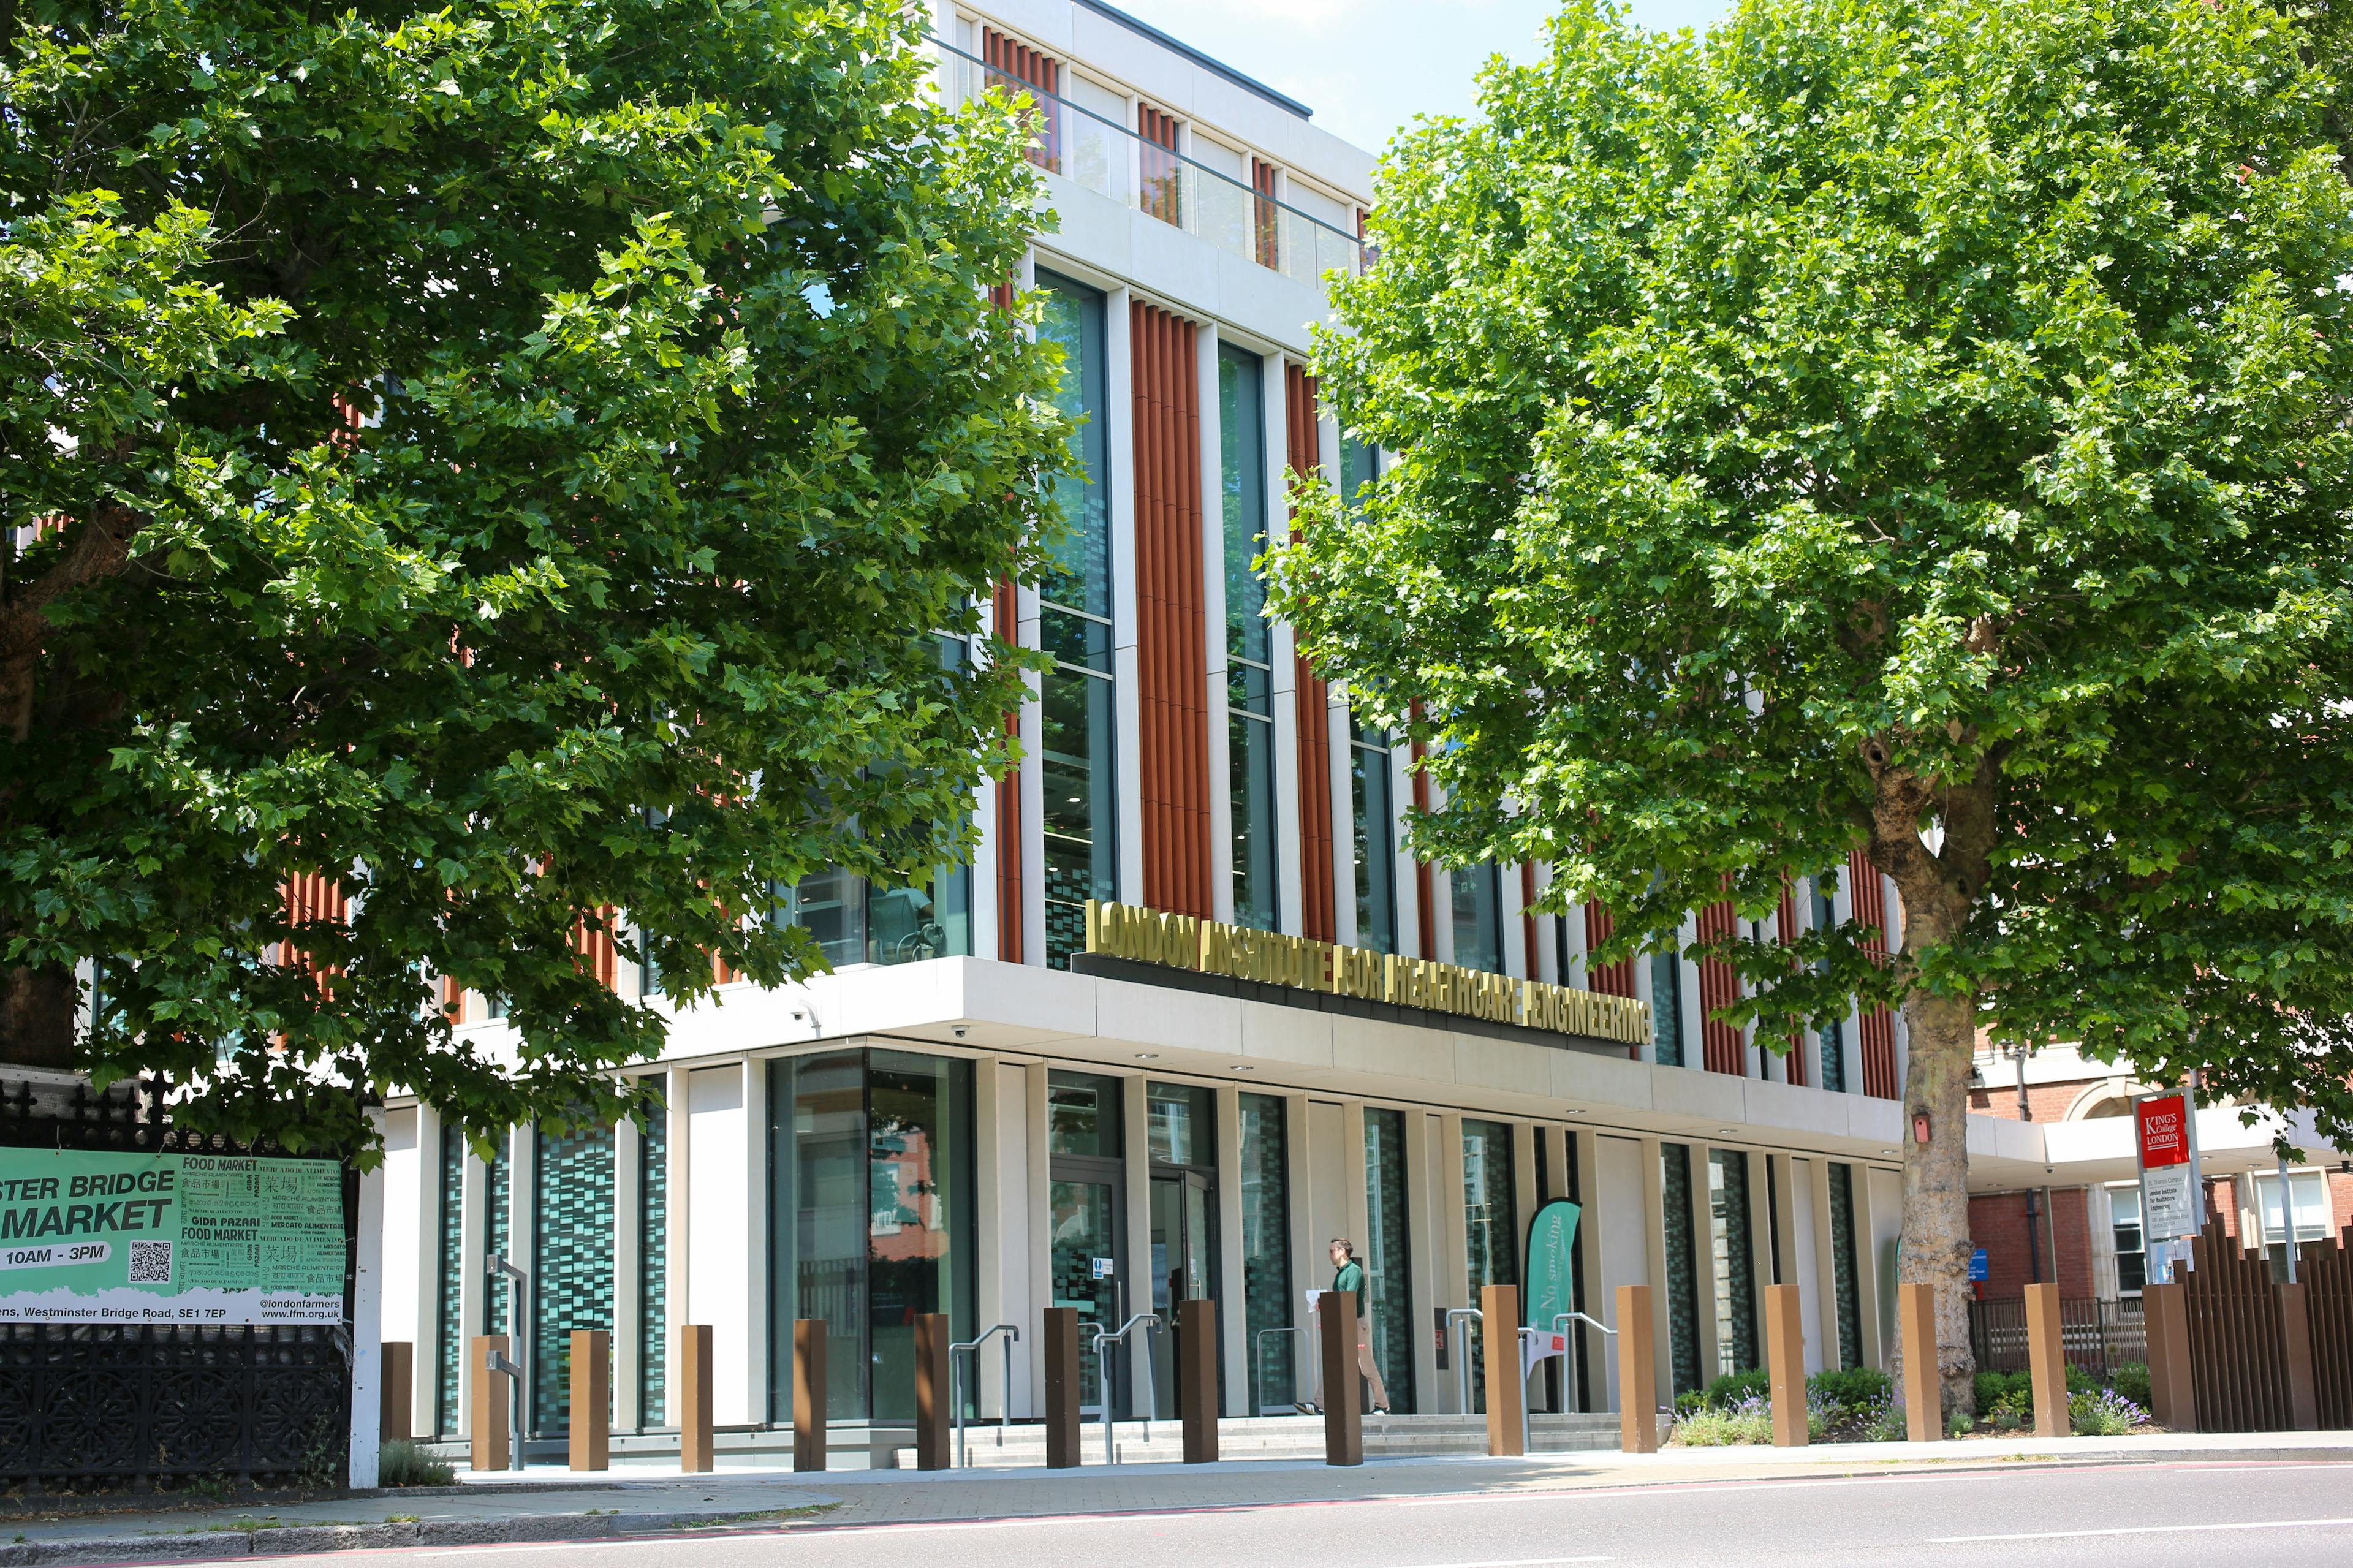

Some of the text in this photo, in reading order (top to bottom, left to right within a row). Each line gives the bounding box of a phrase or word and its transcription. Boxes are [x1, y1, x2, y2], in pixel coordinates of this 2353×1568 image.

[1085, 898, 1652, 1045] LONDON INSTITUTE FOR HEALTHCARE ENGINEERING
[2145, 1113, 2177, 1135] KING'S
[2156, 1124, 2177, 1133] College
[2147, 1132, 2178, 1145] LONDON
[183, 1157, 258, 1171] FOOD MARKET
[0, 1170, 175, 1202] TER BRIDGE
[181, 1178, 220, 1189] 食品市場
[262, 1175, 298, 1194] 菜場
[1, 1198, 172, 1239] MARKET
[192, 1216, 260, 1227] GIDA PAZARI
[181, 1227, 258, 1241] FOOD MARKET
[6, 1249, 52, 1265] 10AM
[69, 1245, 105, 1260] 3PM
[180, 1248, 219, 1259] 食品市場
[262, 1245, 297, 1263] 菜場
[1546, 1215, 1561, 1281] smoking
[306, 1274, 343, 1284] 食品市場
[260, 1299, 339, 1308] @londonfarmers
[1540, 1286, 1556, 1309] No
[0, 1307, 227, 1320] ns, Westminster Bridge Road, SE1 7EP
[262, 1310, 339, 1319] www.lfm.org.uk
